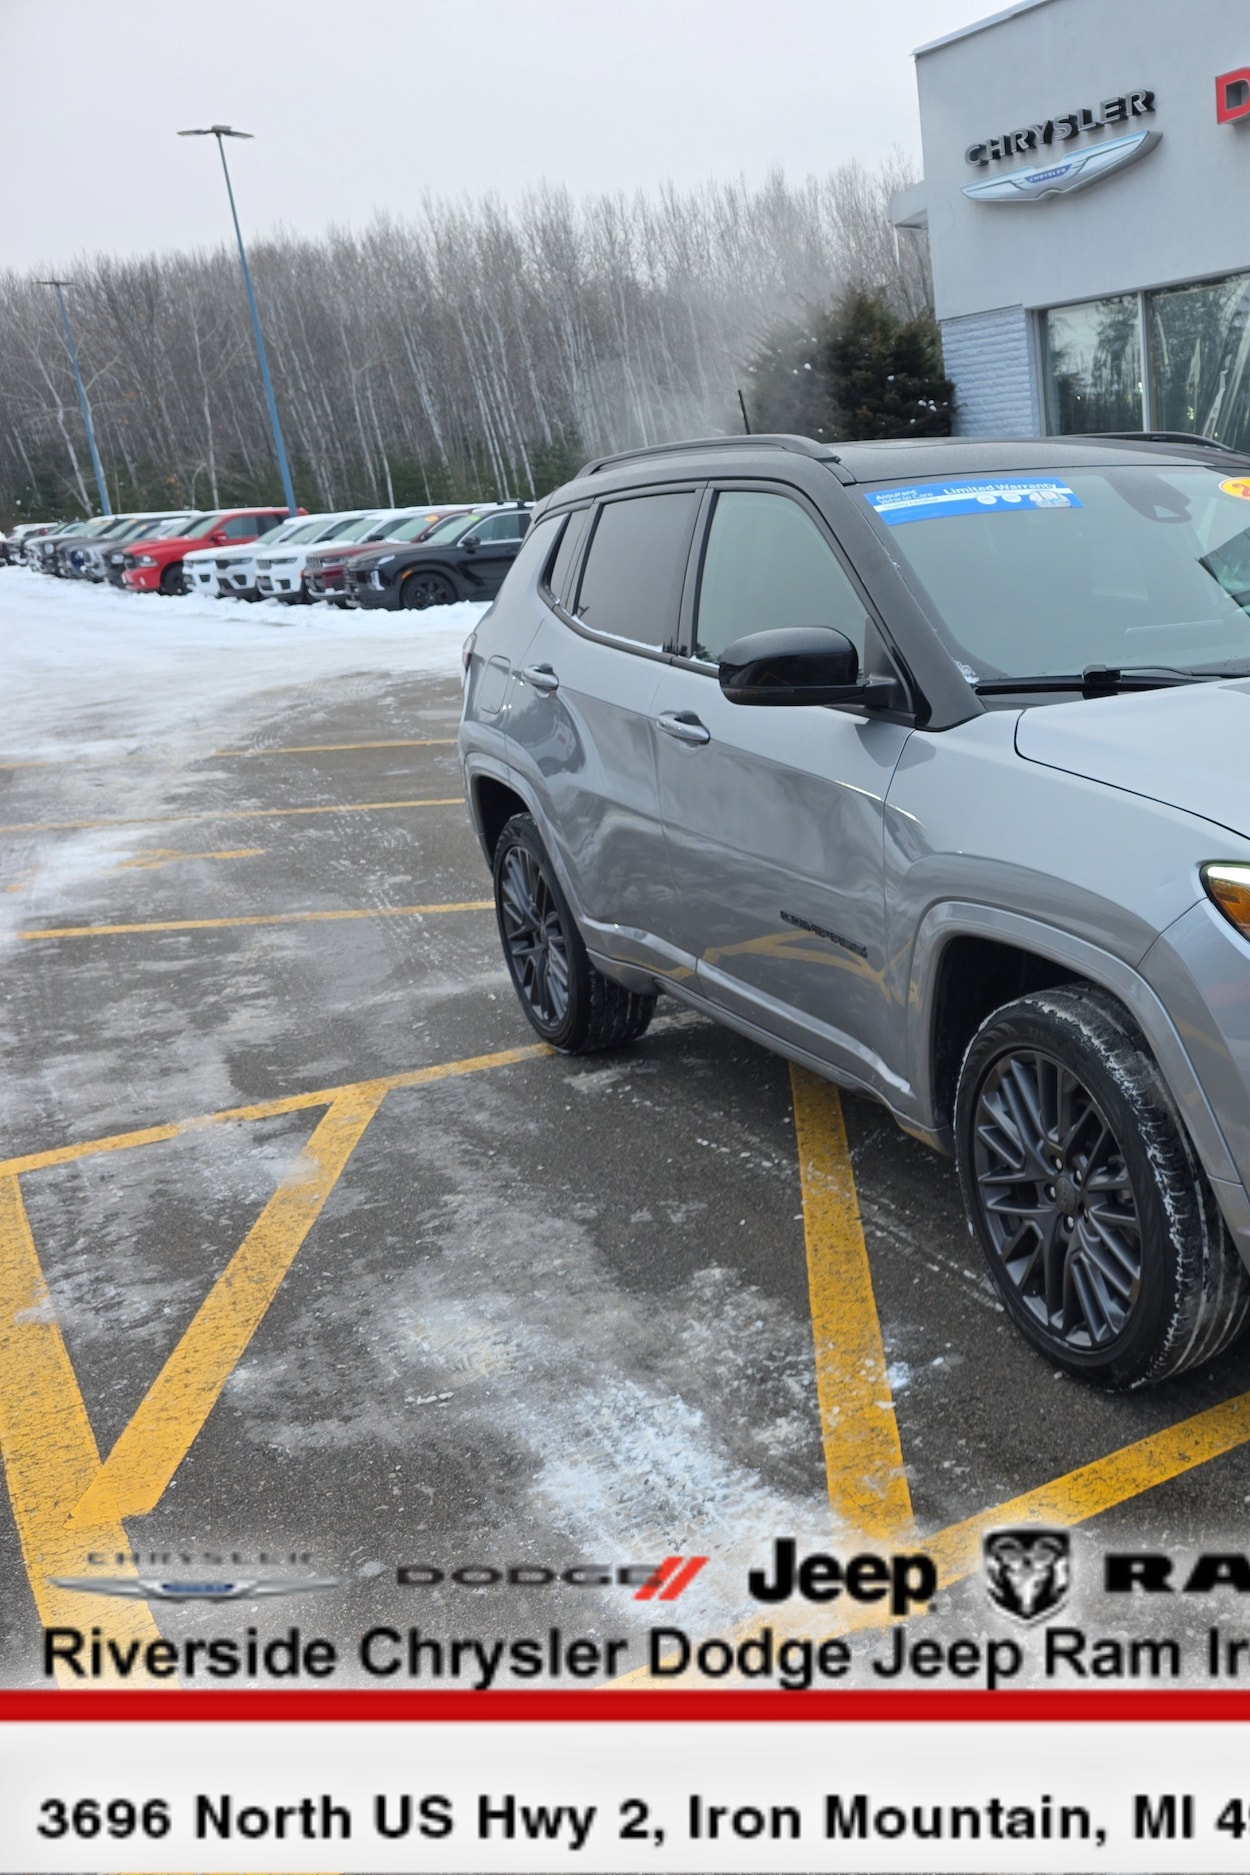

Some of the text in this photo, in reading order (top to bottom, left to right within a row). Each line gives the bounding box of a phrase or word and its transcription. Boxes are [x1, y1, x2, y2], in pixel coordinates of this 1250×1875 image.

[965, 88, 1156, 167] CHRYSLER
[943, 483, 1057, 496] Limited Warranty
